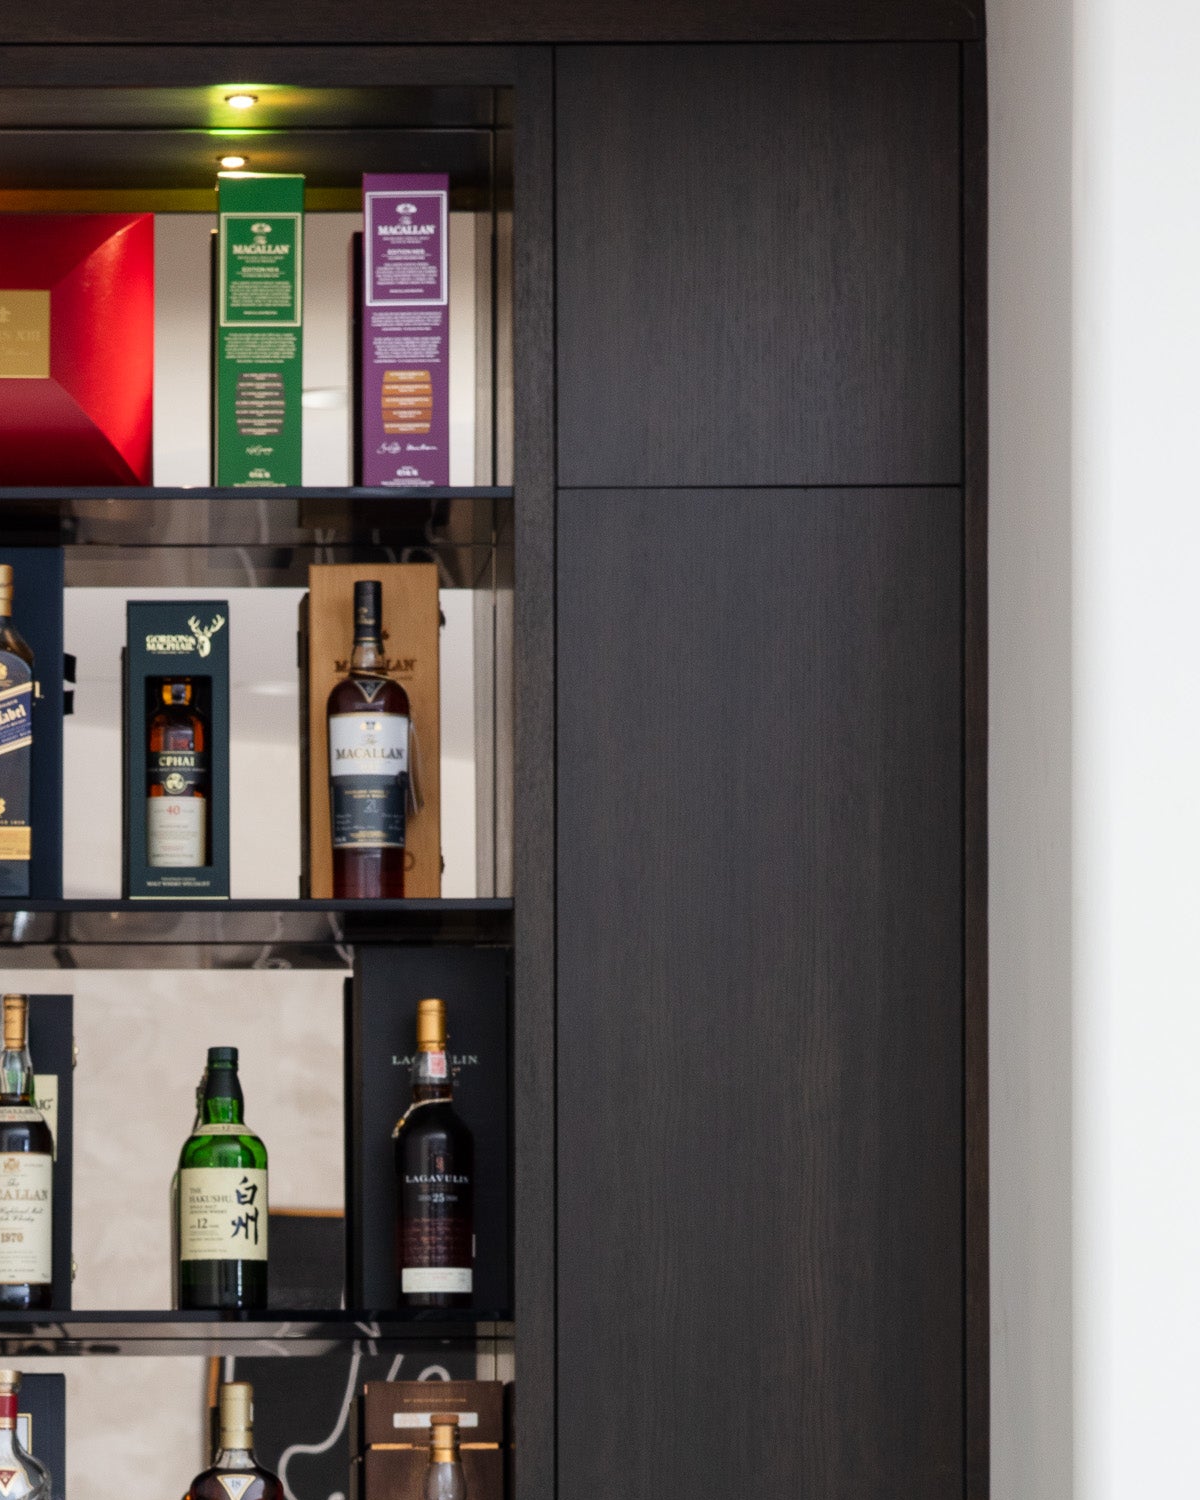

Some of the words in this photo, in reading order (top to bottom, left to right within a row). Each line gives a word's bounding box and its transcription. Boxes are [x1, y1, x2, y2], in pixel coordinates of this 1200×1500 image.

[377, 225, 436, 235] MACALLAN
[232, 245, 290, 254] MACALLAN
[335, 748, 405, 760] MACALLAN
[432, 1192, 445, 1203] 25
[230, 1175, 260, 1246] 白州
[196, 1218, 208, 1229] 12
